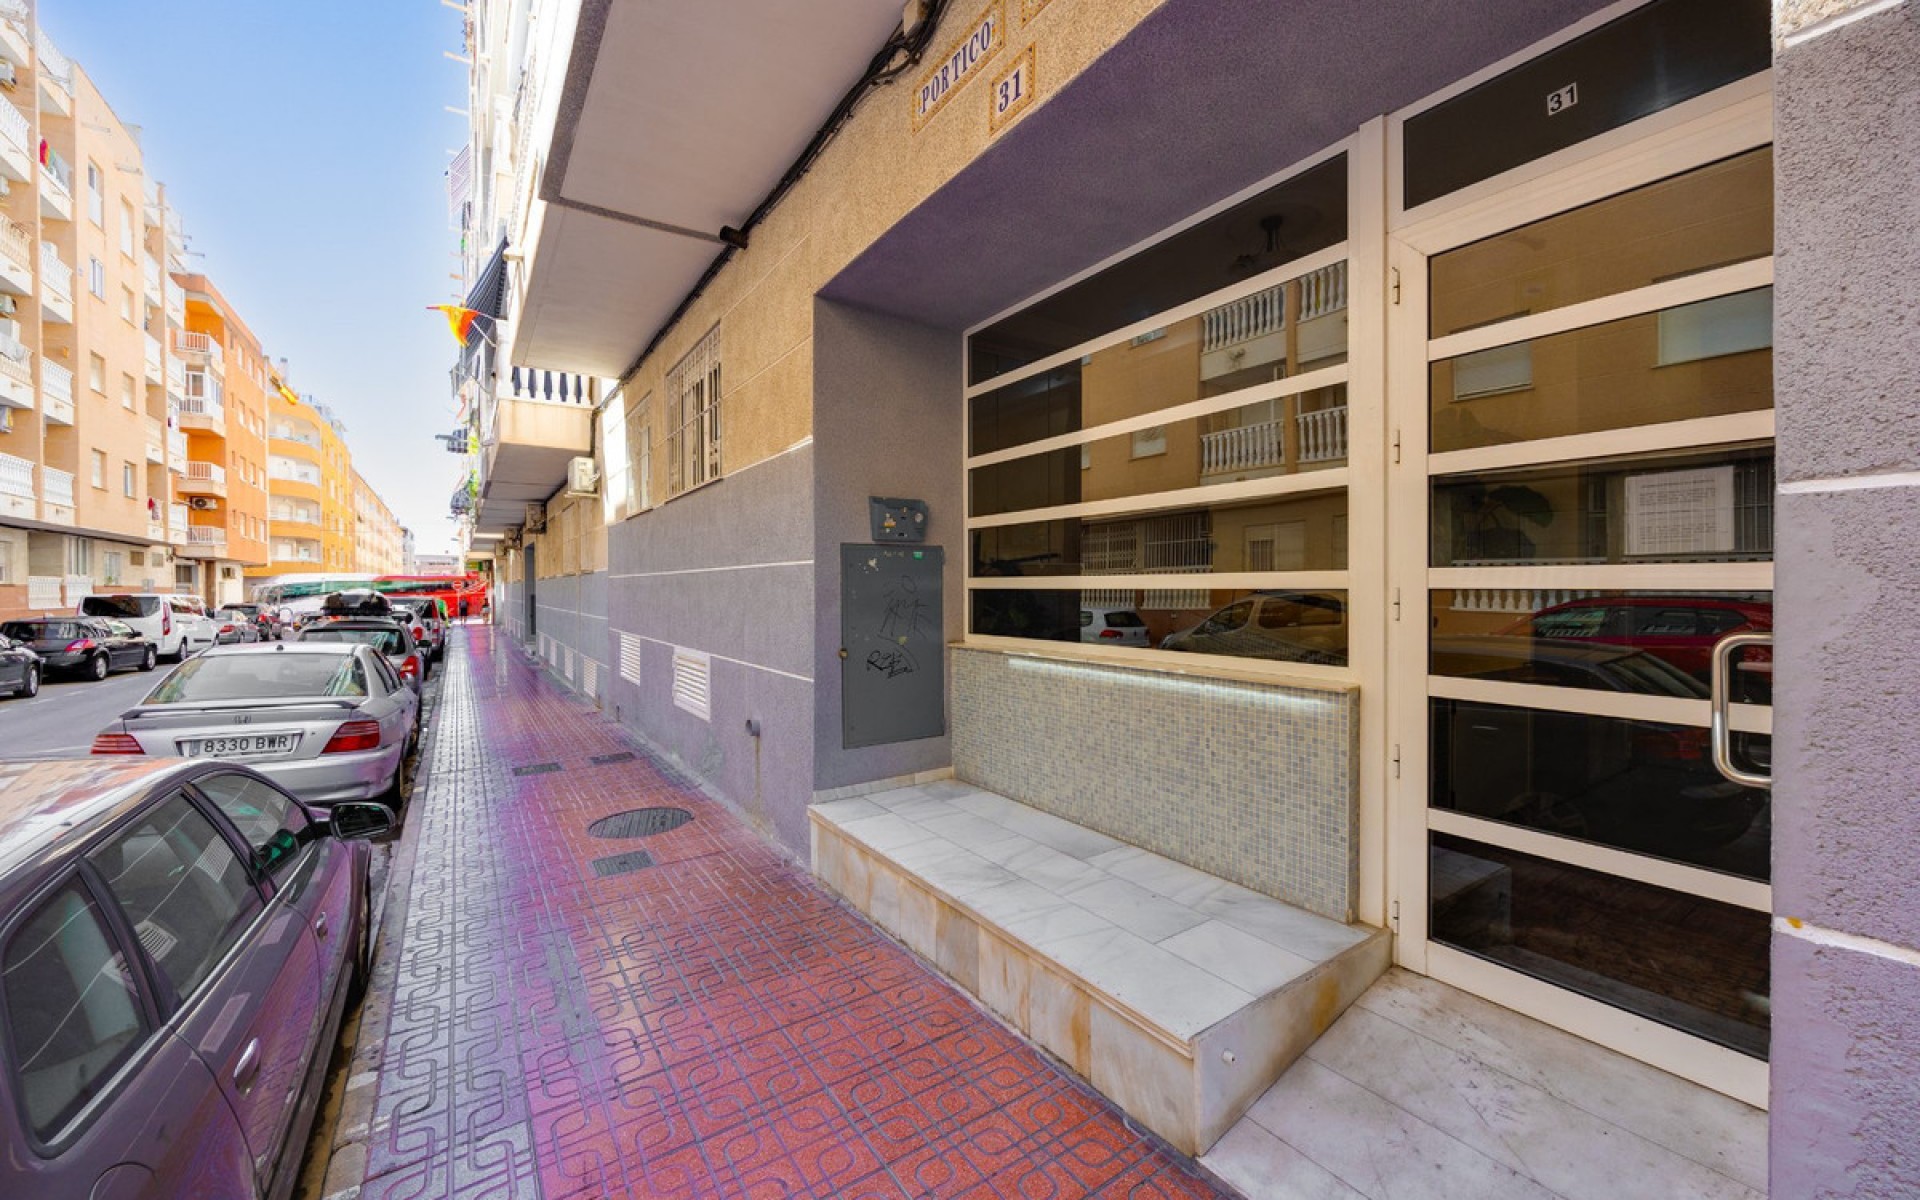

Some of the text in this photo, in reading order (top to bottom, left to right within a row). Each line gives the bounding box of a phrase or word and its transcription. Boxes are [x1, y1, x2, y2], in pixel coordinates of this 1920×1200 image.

[920, 21, 991, 114] PORTICO
[998, 69, 1021, 113] 31
[1550, 86, 1575, 112] 31
[204, 736, 287, 753] 8330 BWR
